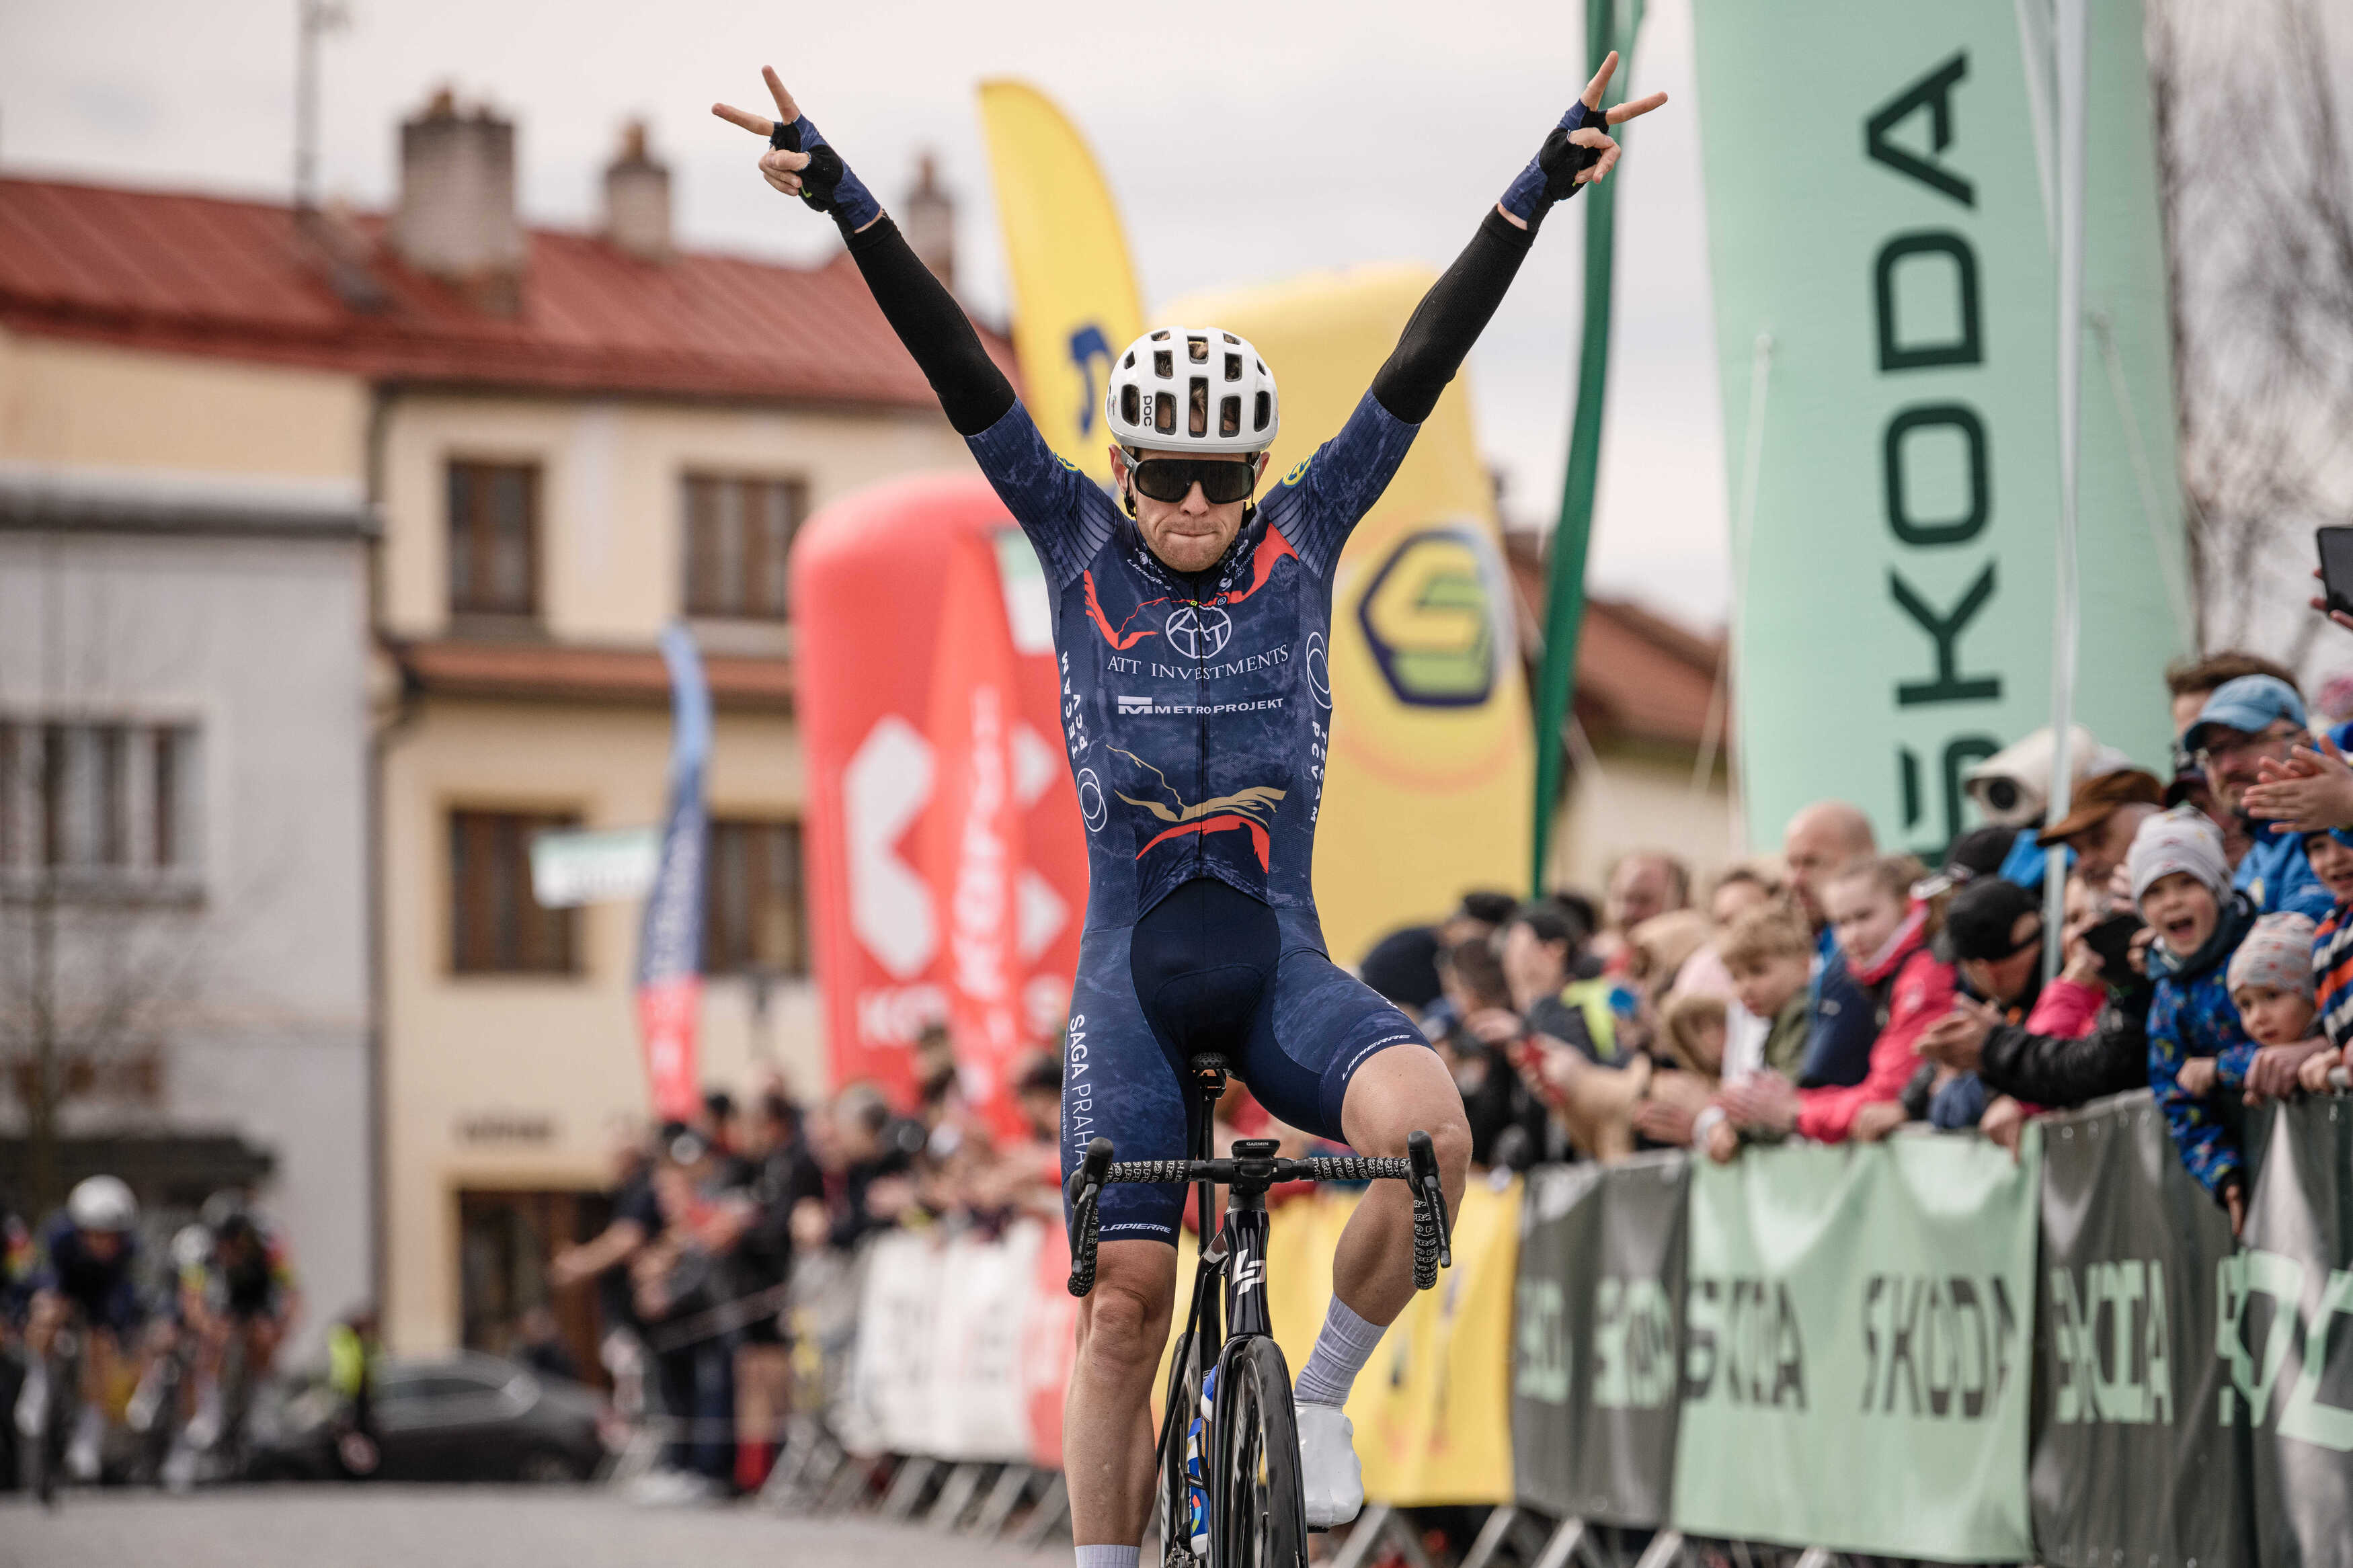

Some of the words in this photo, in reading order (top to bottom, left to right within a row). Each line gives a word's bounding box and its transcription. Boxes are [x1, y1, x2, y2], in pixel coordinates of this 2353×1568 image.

[1107, 655, 1142, 674] ATT
[1151, 644, 1289, 680] INVESTMENTS
[1155, 698, 1283, 714] METROPROJEKT
[1070, 1014, 1089, 1080] SAGA
[1072, 1083, 1094, 1166] PRAHA
[1099, 1223, 1172, 1234] LAPIERRE
